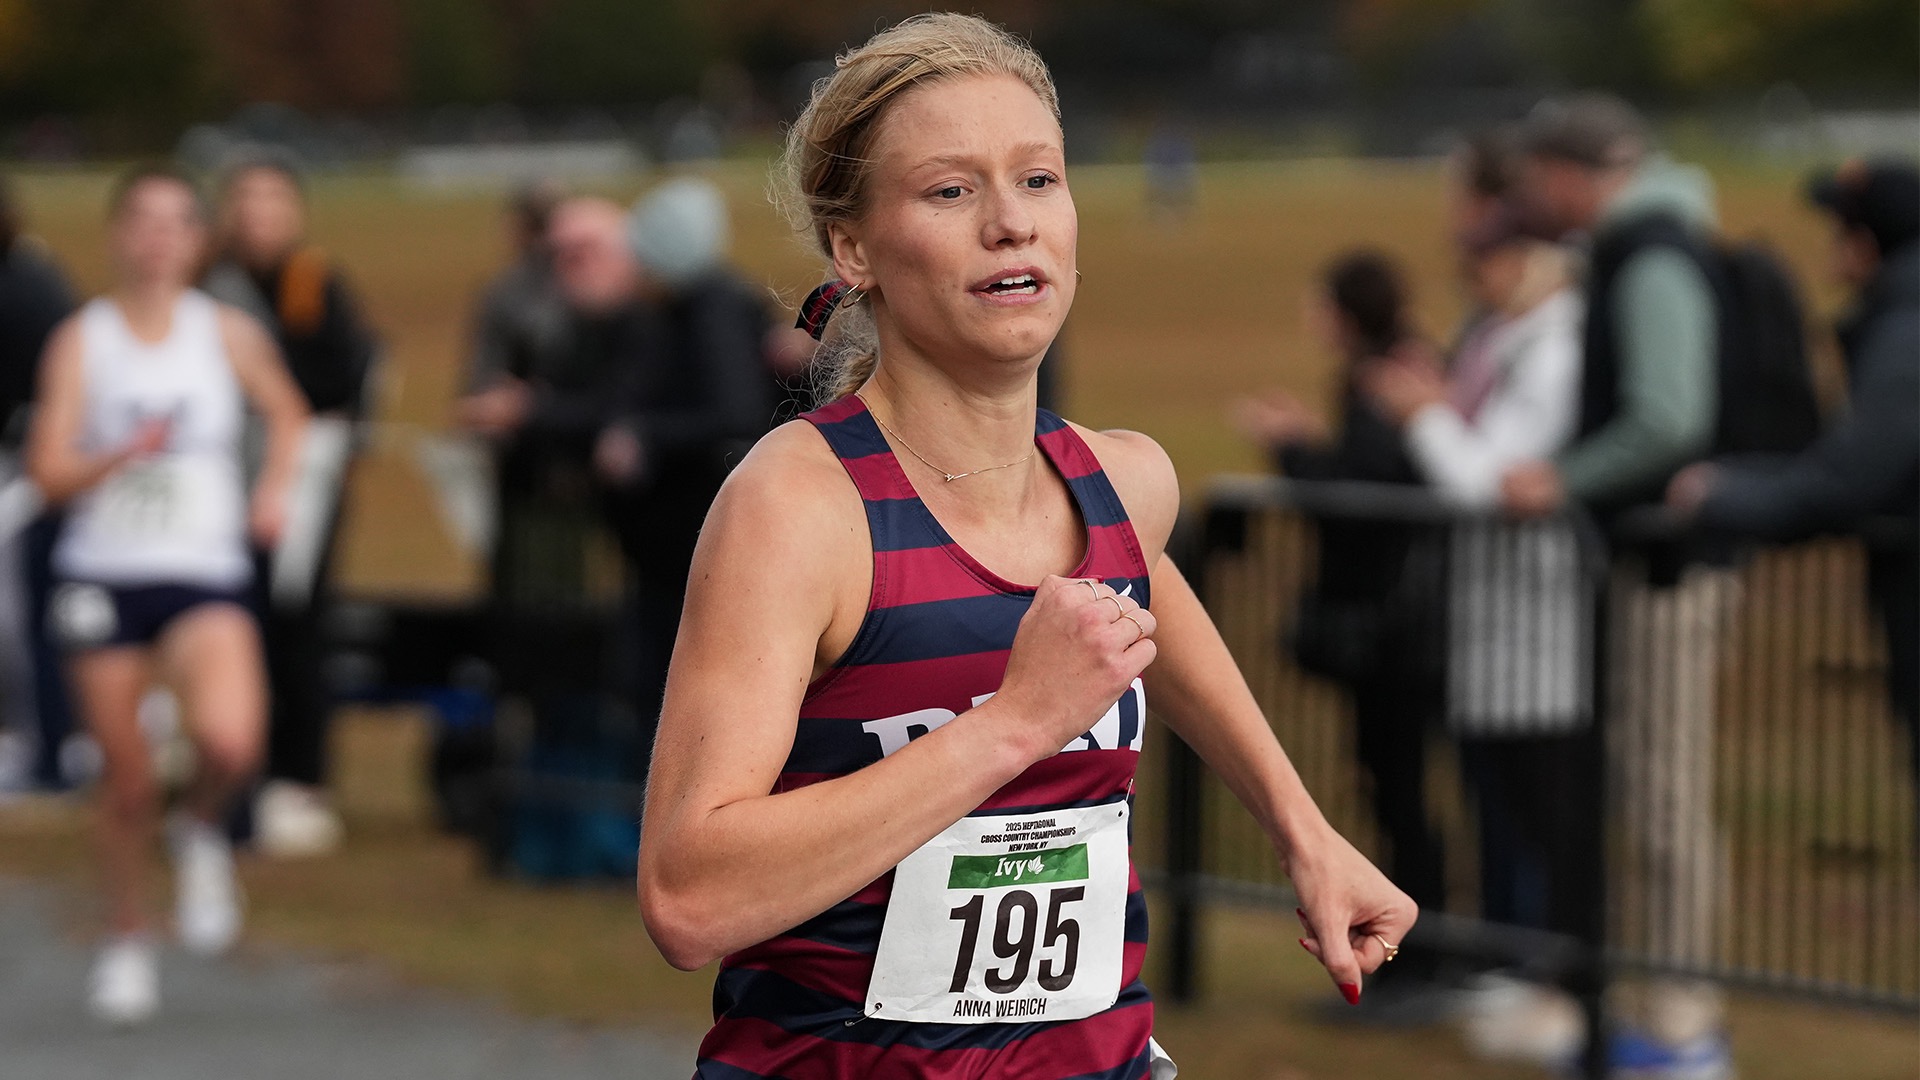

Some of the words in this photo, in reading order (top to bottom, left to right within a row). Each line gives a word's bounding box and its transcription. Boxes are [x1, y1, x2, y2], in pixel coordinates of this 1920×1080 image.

[1005, 823, 1022, 832] 2025
[1022, 818, 1056, 830] HEPTAGONAL
[980, 834, 1003, 844] CROSS
[1003, 832, 1031, 842] COUNTRY
[1030, 826, 1077, 840] CHAMPIONSHIPS
[1008, 843, 1023, 852] NEW
[1040, 841, 1048, 849] NY
[995, 857, 1028, 880] Ivy
[949, 886, 1085, 994] 195
[953, 999, 991, 1018] ANNA
[995, 998, 1047, 1017] WEIRICH
